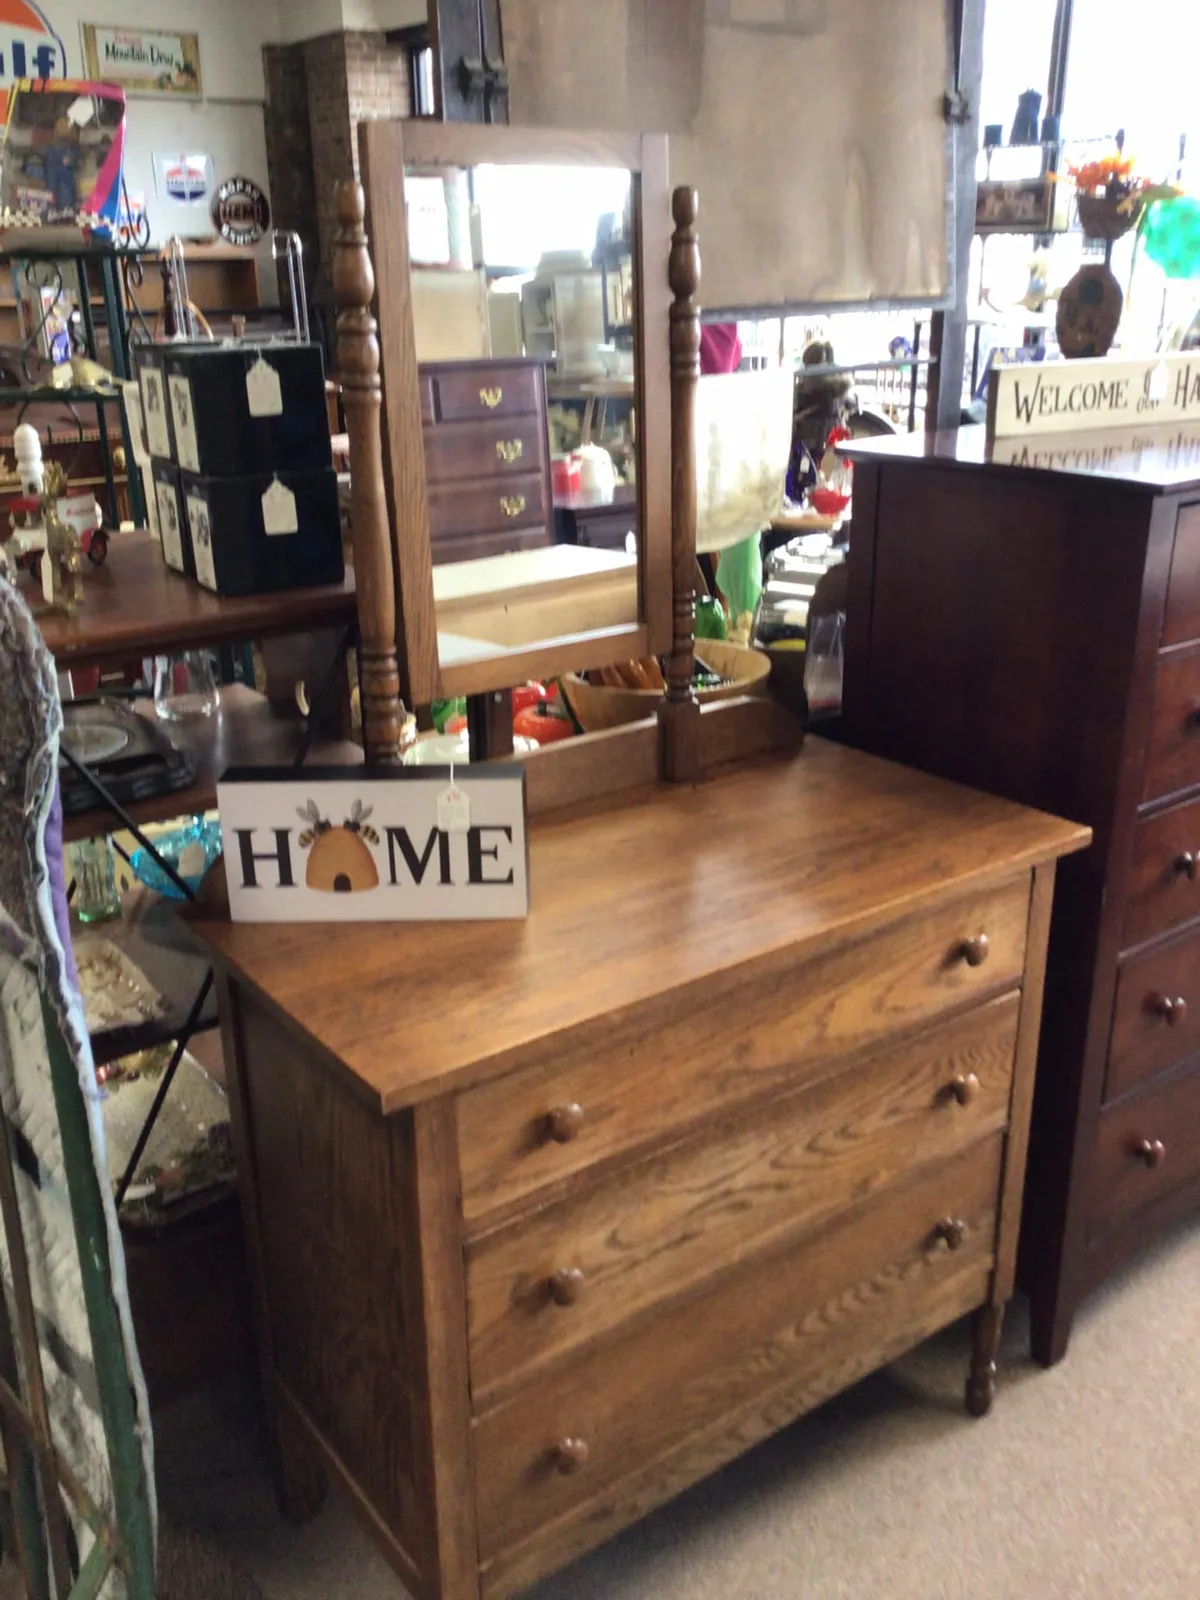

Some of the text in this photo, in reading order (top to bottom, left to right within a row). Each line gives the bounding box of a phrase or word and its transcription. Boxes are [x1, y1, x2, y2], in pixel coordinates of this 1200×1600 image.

[0, 41, 56, 79] lf
[104, 41, 174, 67] Mountain Dew
[1014, 373, 1129, 423] WELCOME
